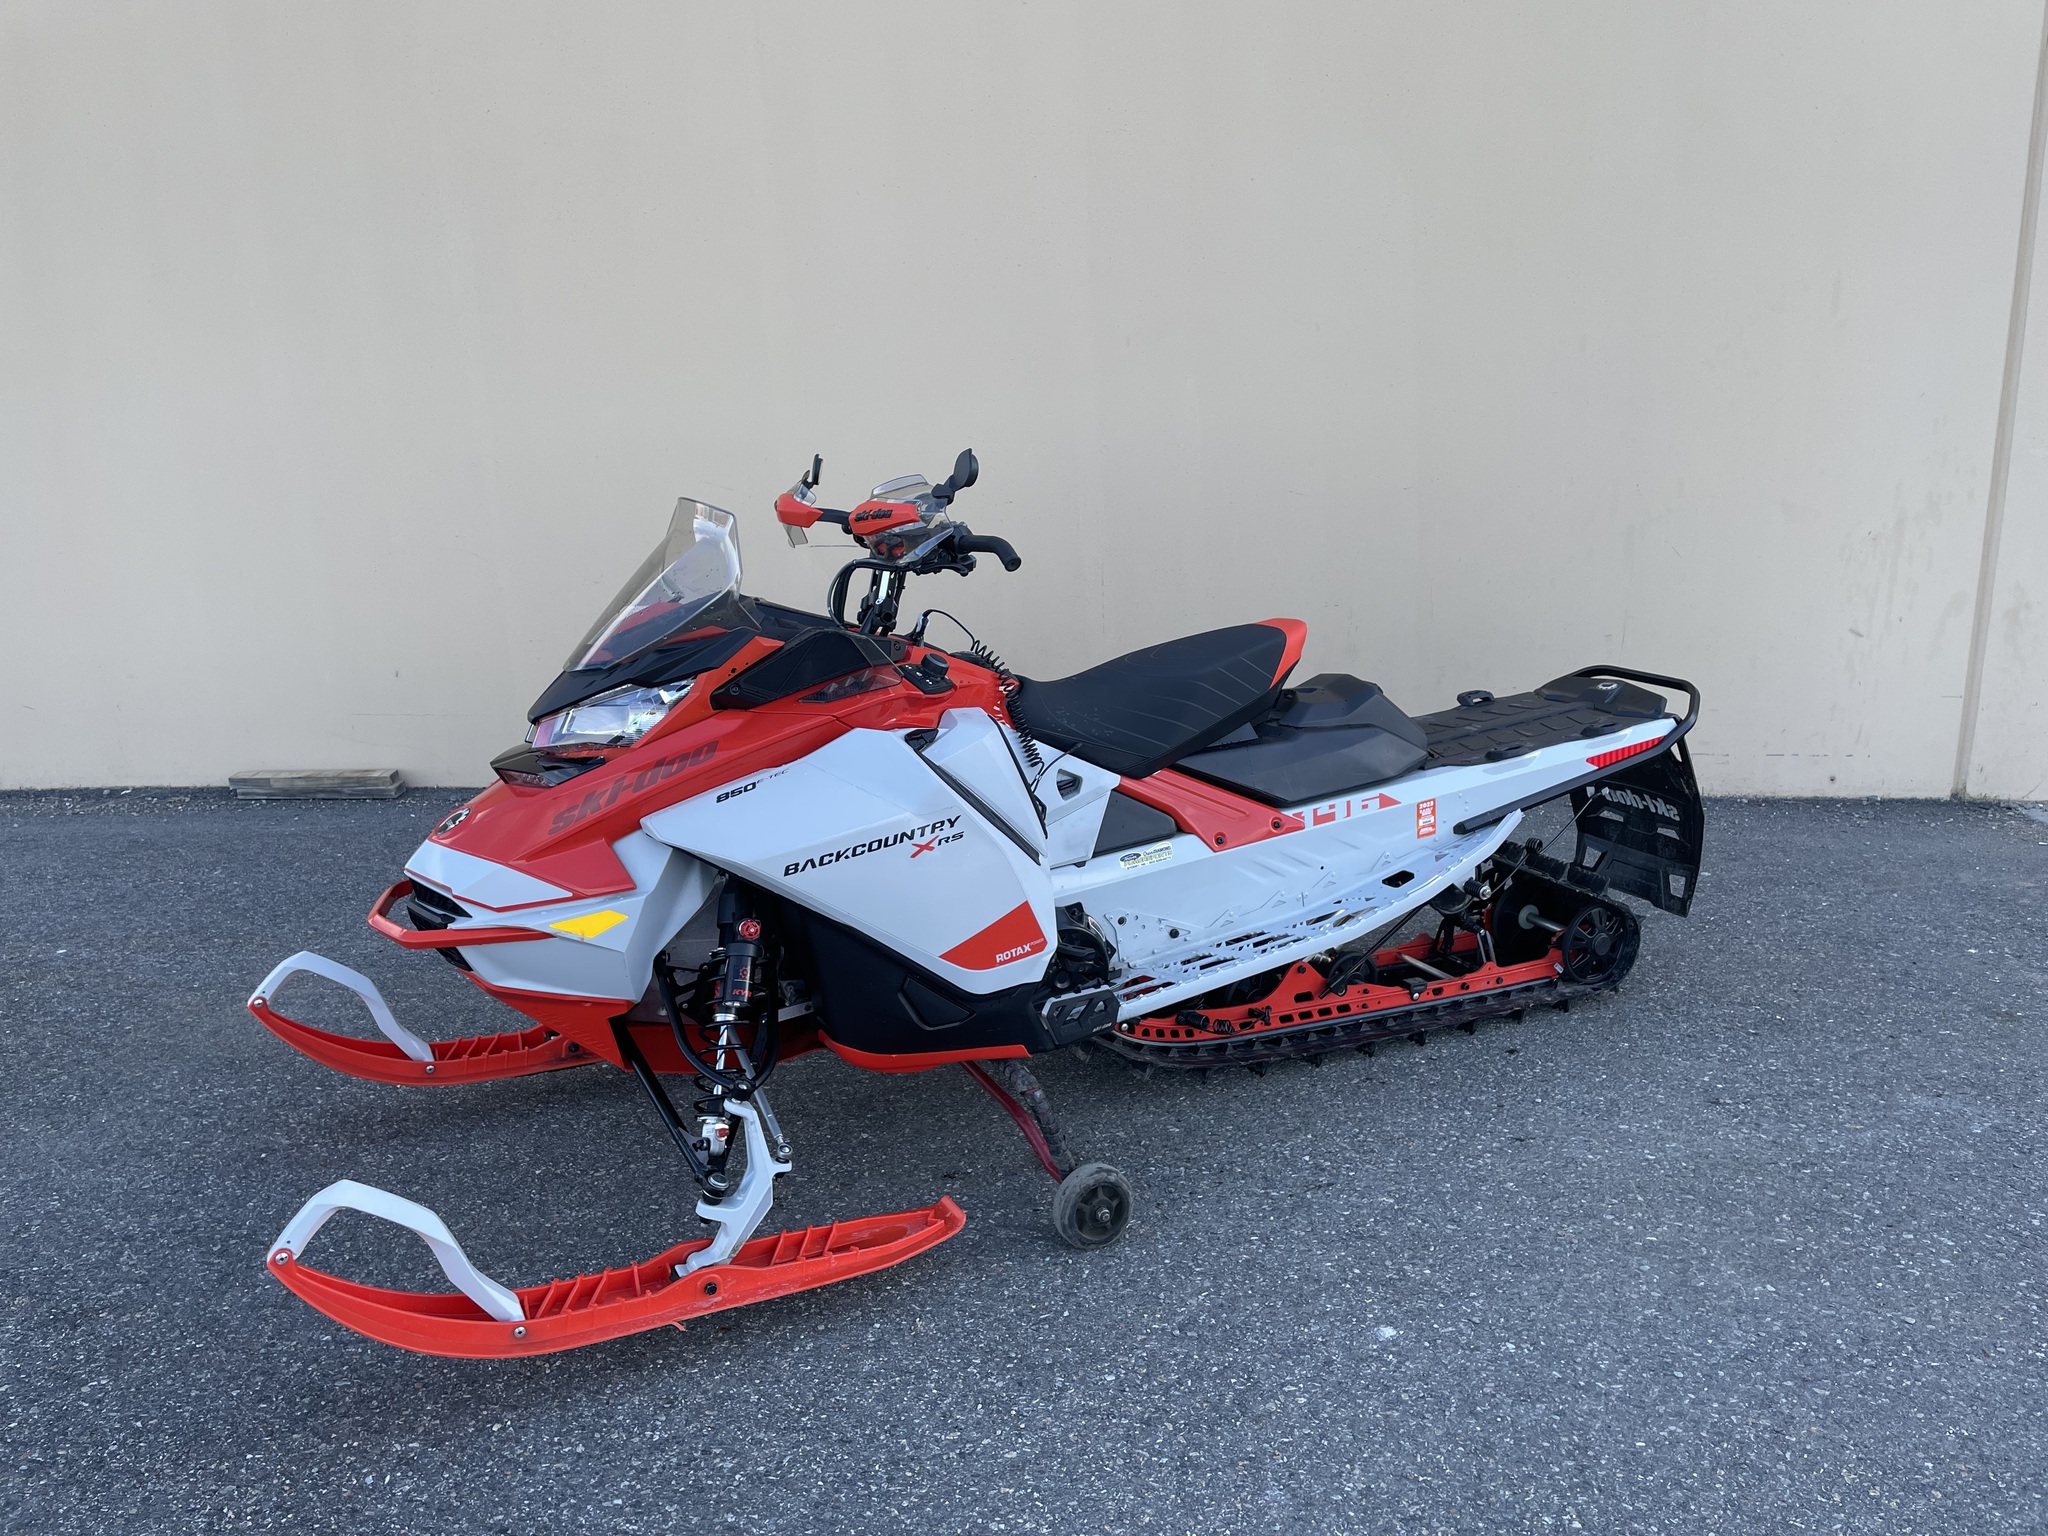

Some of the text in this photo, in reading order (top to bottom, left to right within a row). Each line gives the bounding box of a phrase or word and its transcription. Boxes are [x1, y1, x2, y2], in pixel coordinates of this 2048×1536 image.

[547, 740, 720, 836] ski-doo
[716, 781, 758, 804] 850
[783, 815, 962, 877] BACKCOUNTRY
[995, 943, 1032, 963] ROTAX
